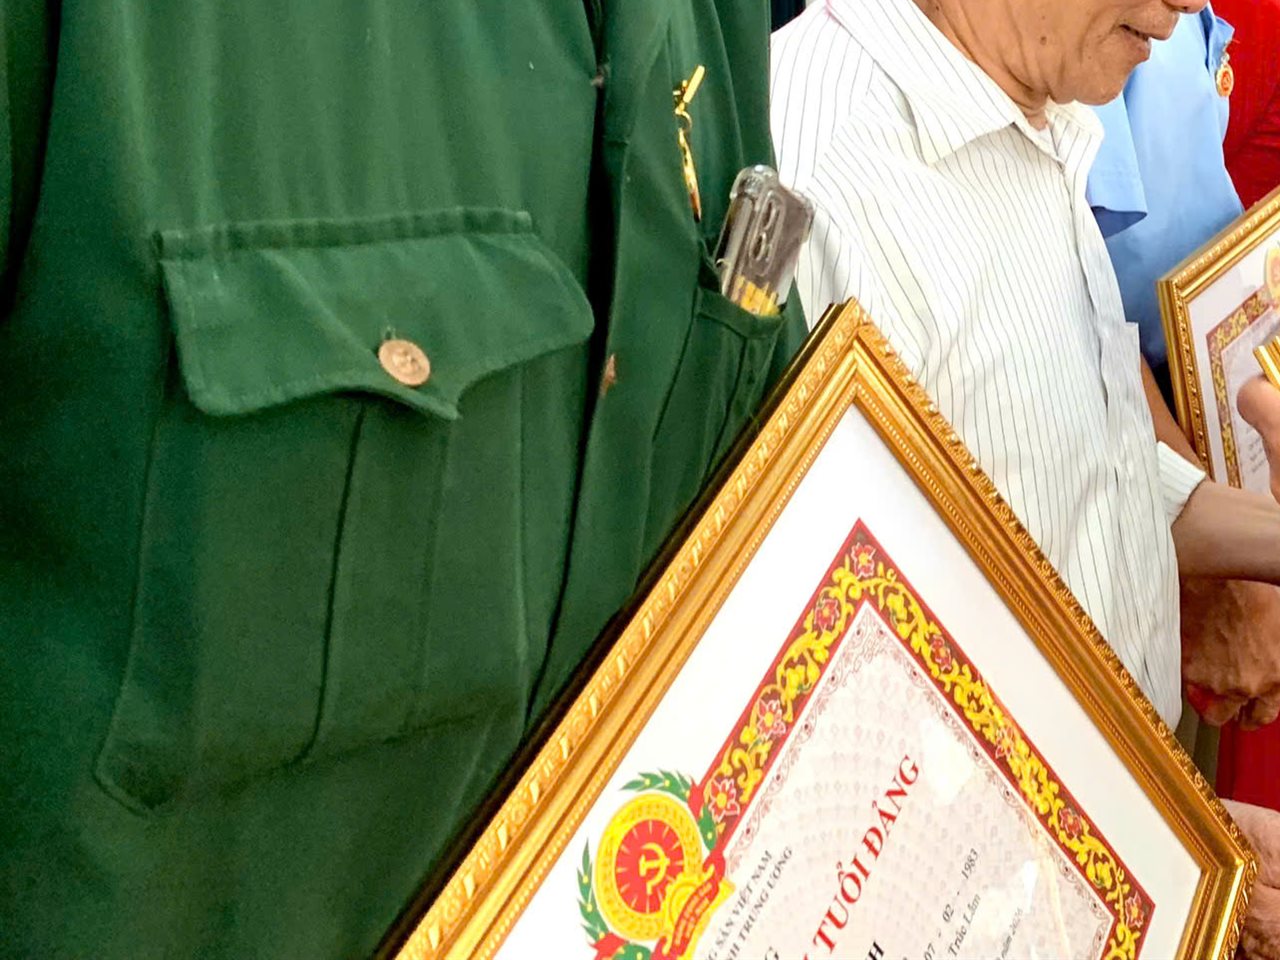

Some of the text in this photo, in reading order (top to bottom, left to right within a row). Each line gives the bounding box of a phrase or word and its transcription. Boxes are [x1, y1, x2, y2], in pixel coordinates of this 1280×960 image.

[751, 850, 773, 884] NAM
[813, 755, 919, 954] TUỔI ĐẢNG
[942, 904, 954, 923] 02
[961, 848, 978, 880] 1983
[739, 891, 769, 942] TRUNG
